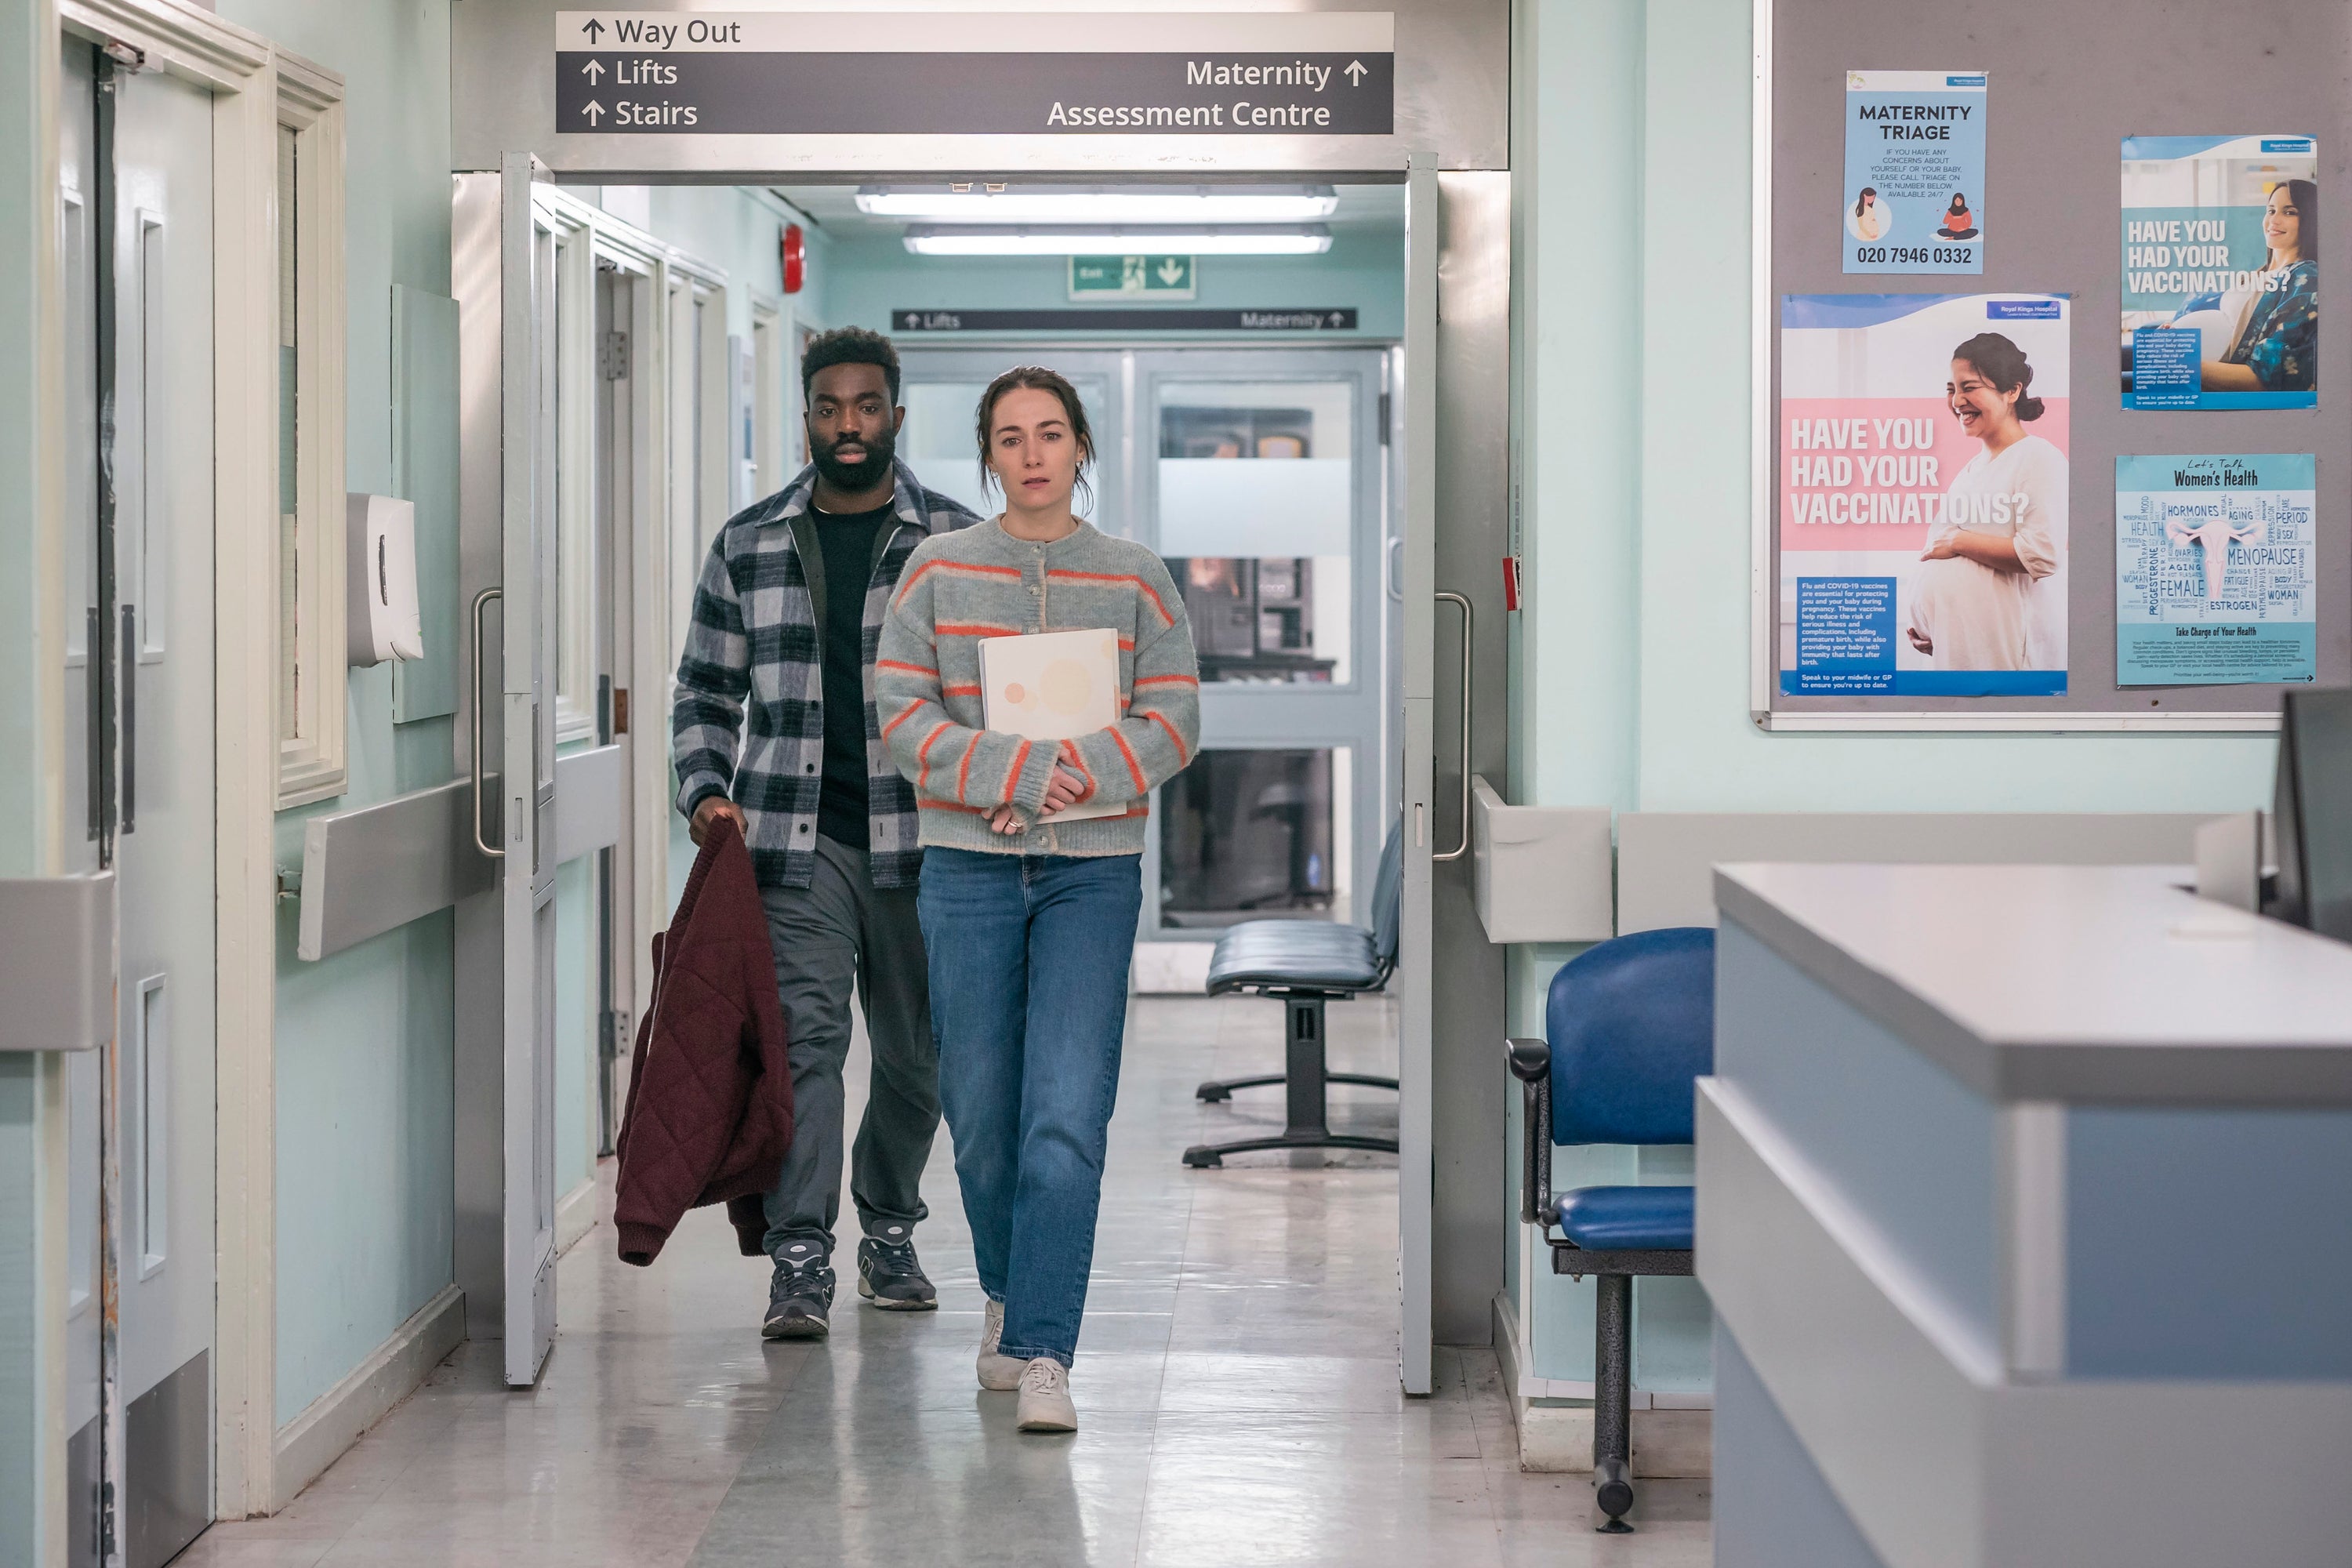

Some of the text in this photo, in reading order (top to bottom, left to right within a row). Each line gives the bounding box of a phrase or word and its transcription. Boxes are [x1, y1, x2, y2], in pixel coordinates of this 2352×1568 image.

[615, 20, 740, 50] Way Out
[618, 60, 677, 84] Lifts
[1188, 60, 1331, 92] Maternity
[616, 101, 697, 125] Stairs
[1047, 102, 1330, 125] Assessment Centre
[1860, 105, 1972, 120] MATERNITY
[1880, 125, 1950, 140] TRIAGE
[2128, 220, 2225, 242] HAVE YOU
[1857, 247, 1972, 263] 020 7946 0332
[2128, 246, 2229, 268] HAD YOUR
[2128, 270, 2291, 293] VACCINATIONS?
[924, 313, 960, 329] Lifts
[1242, 311, 1323, 331] Maternity
[1791, 418, 1933, 449] HAVE YOU
[1791, 456, 1939, 486] HAD YOUR
[2188, 459, 2244, 470] Let's Talk
[2175, 470, 2257, 486] Women's Health
[1791, 492, 2030, 524] VACCINATIONS?
[2168, 505, 2219, 517] HORMONES
[2228, 510, 2253, 520] AGING
[2276, 512, 2308, 524] PERIOD
[2131, 521, 2164, 536] HEALTH
[2282, 530, 2294, 539] SEX
[2175, 549, 2203, 557] OVARIES
[2227, 548, 2297, 565] MENOPAUSE
[2122, 575, 2148, 583] WOMAN
[2149, 546, 2159, 615] PROGESTERONE
[2224, 576, 2249, 586] FATIGUE
[2160, 579, 2205, 597] FEMALE
[2267, 590, 2299, 600] WOMAN
[2210, 601, 2257, 610] ESTROGEN
[2176, 626, 2256, 638] Take Charge of Your Health
